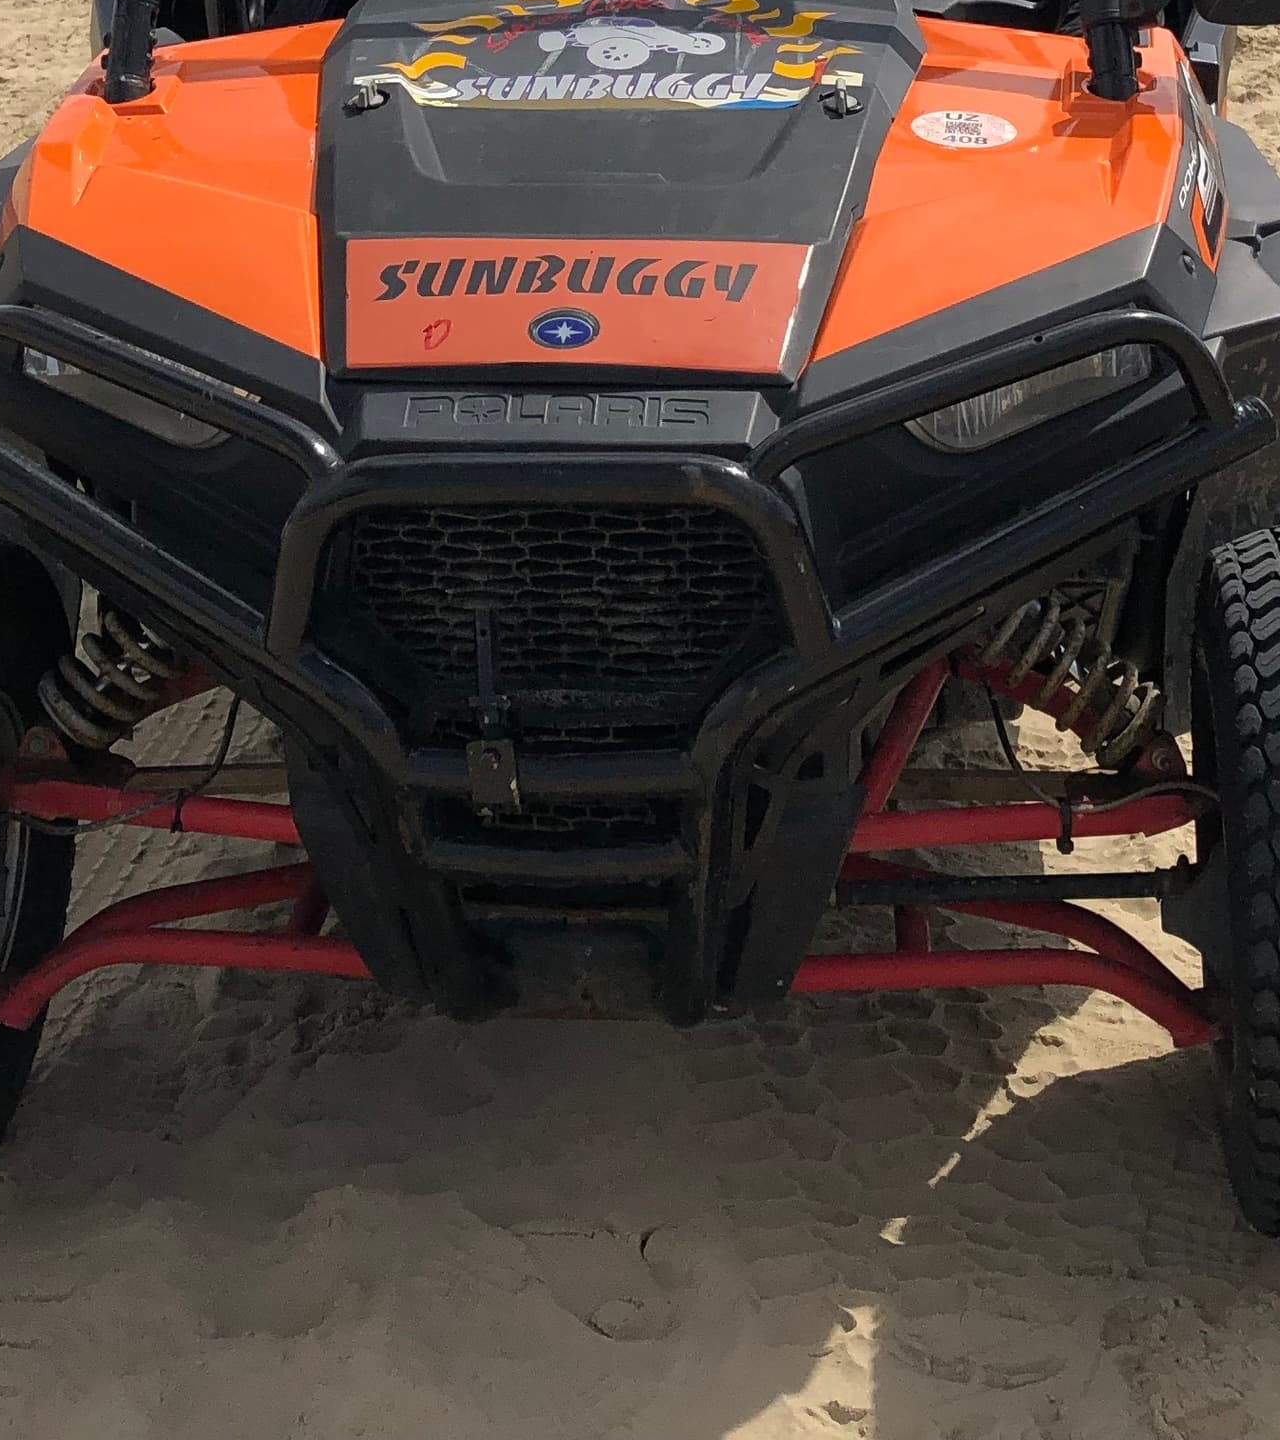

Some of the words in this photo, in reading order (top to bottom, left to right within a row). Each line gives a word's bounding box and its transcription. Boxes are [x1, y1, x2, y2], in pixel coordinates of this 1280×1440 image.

[454, 72, 774, 102] SUNBUGGY
[945, 112, 980, 123] UZ
[942, 135, 988, 145] 408
[374, 254, 758, 303] SUNBUGGY
[402, 393, 710, 429] POLARIS
